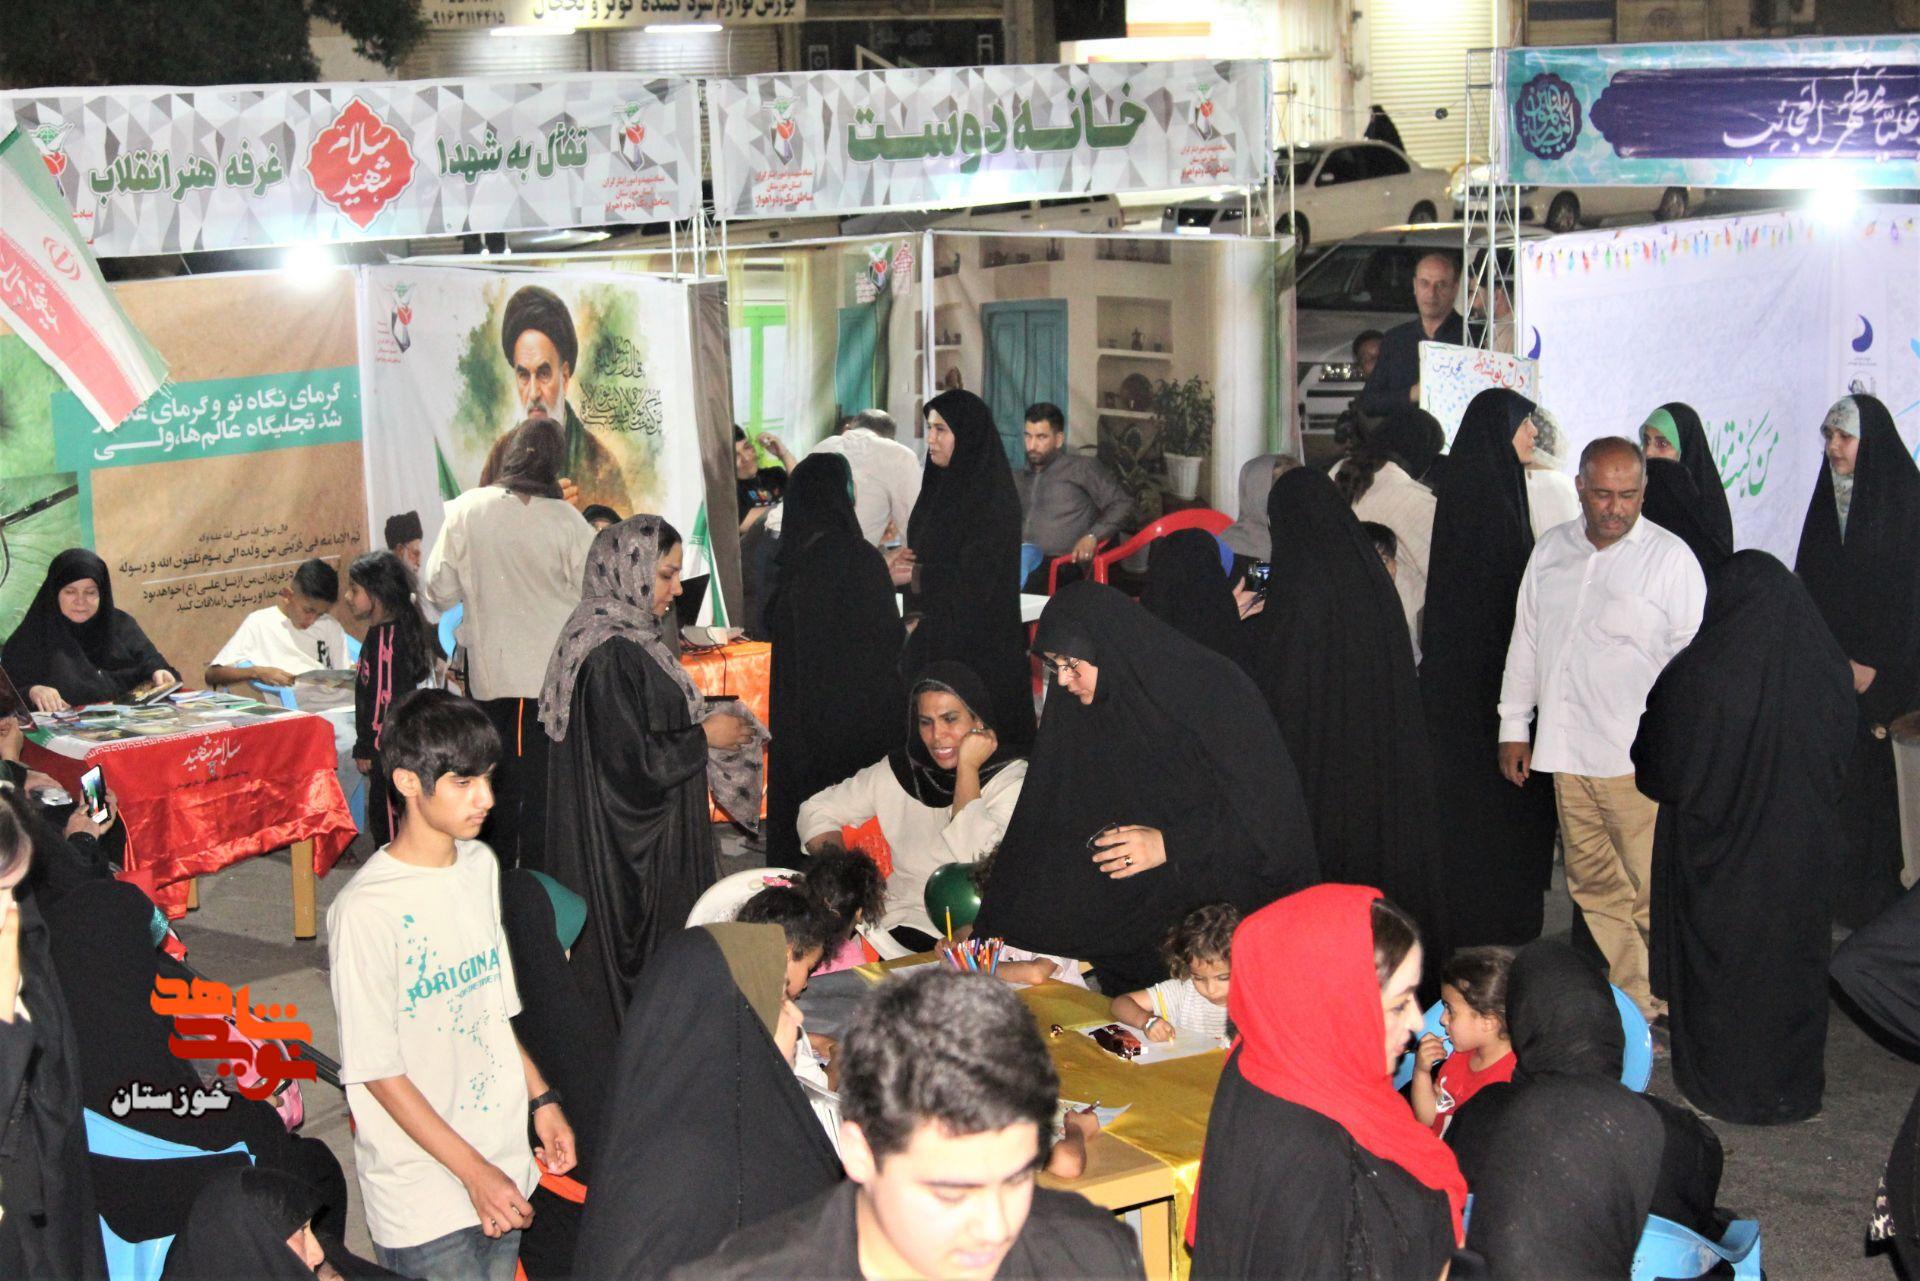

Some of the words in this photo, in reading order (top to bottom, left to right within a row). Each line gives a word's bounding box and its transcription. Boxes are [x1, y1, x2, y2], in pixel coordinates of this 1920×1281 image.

[845, 96, 1007, 174] دوست
[1014, 80, 1148, 152] خانه
[327, 121, 391, 165] سلام
[436, 130, 504, 184] شهدا
[507, 136, 533, 183] به
[89, 149, 172, 206] انقلاب
[172, 153, 218, 203] هنر
[224, 137, 284, 197] غرفه
[333, 156, 392, 206] شهید
[151, 397, 208, 425] گرمای
[211, 398, 221, 420] و
[227, 394, 244, 421] تو
[246, 387, 287, 410] نگاه
[289, 382, 341, 410] گرمای
[246, 414, 316, 439] تجلیگاه
[318, 410, 342, 429] شد
